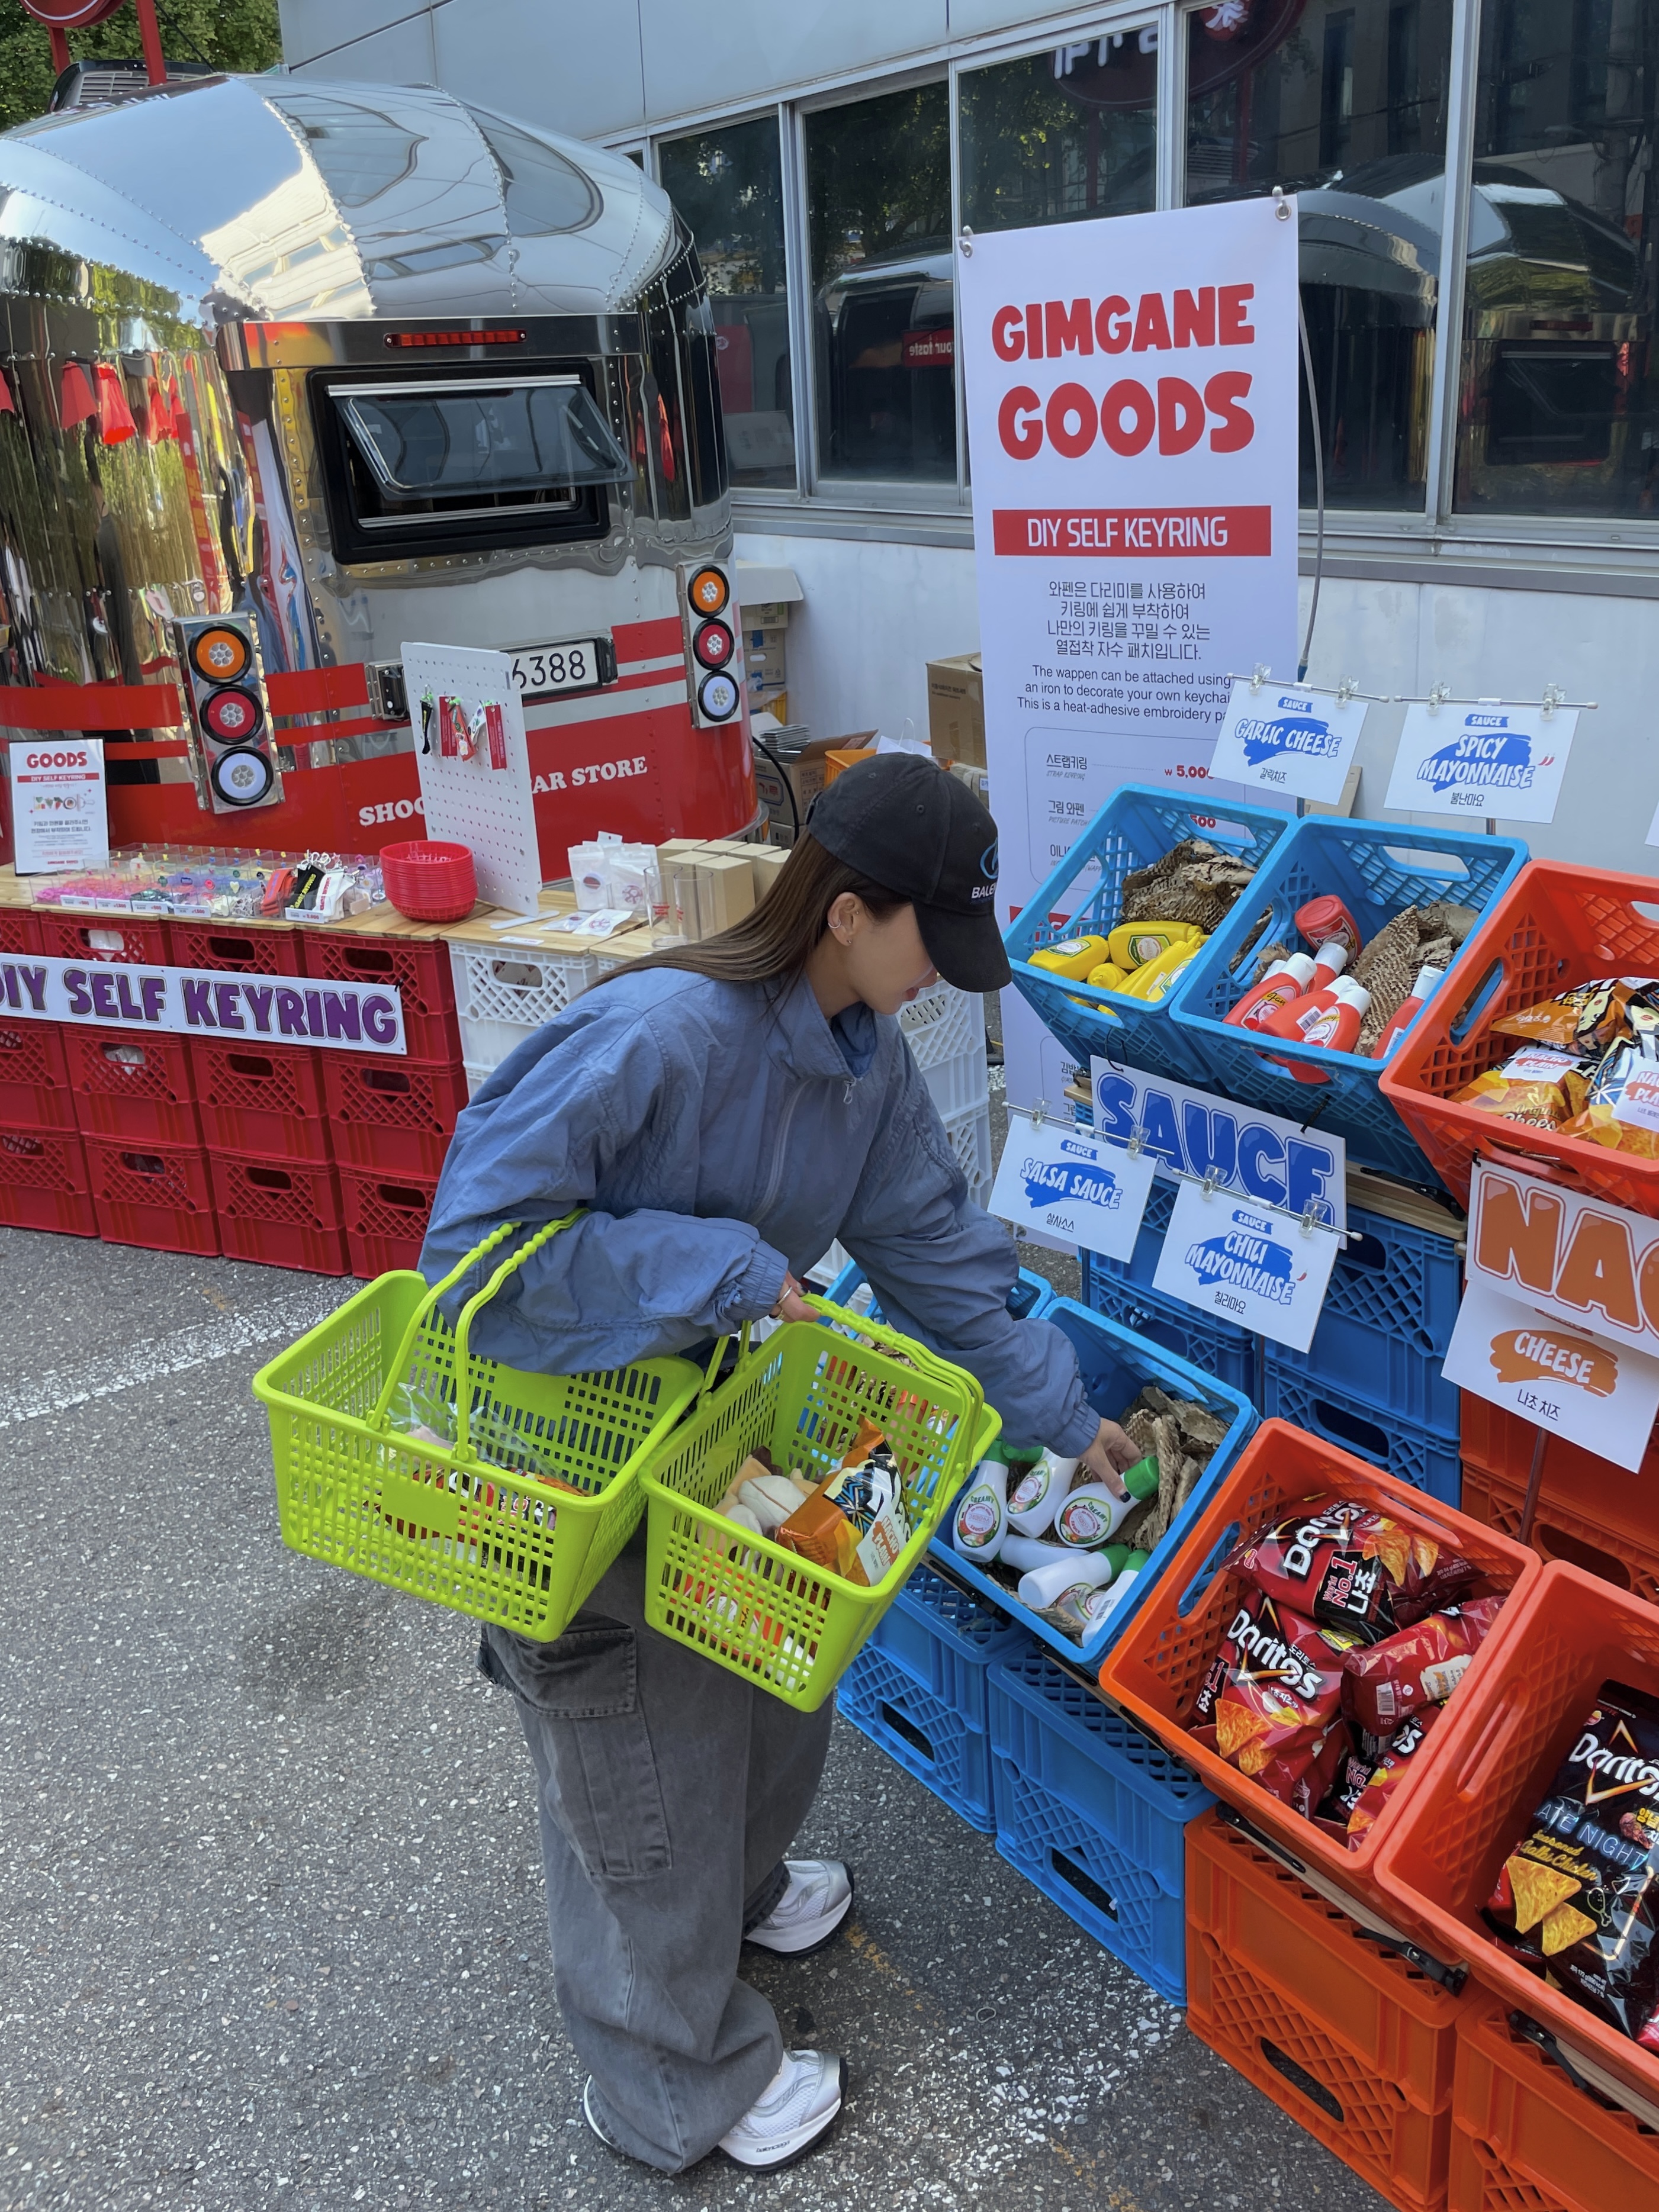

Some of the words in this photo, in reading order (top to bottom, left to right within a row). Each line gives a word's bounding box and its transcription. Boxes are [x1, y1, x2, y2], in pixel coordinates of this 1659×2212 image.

[992, 283, 1255, 362] GIMGANE
[998, 371, 1255, 460] GOODS
[1027, 519, 1061, 548] DIY
[1068, 518, 1118, 547] SELF
[1124, 516, 1228, 547] KEYRING
[1049, 581, 1087, 598] 와펜은
[1090, 582, 1144, 599] 다리미를
[1147, 582, 1206, 600] 사용하여
[1060, 601, 1098, 618] 키링에
[1102, 601, 1128, 619] 쉽게
[1132, 603, 1189, 620] 부착하여
[1047, 620, 1085, 637] 나만의
[1088, 621, 1127, 639] 키링을
[1131, 623, 1159, 639] 꾸밀
[1162, 624, 1177, 640] 수
[1181, 623, 1211, 640] 있는
[1056, 639, 1094, 656] 열접착
[1098, 641, 1124, 658] 자수
[1127, 642, 1202, 661] 패치입니다.
[1032, 665, 1053, 678] The
[1056, 669, 1098, 682] wappen
[1101, 669, 1121, 681] can
[1124, 670, 1139, 682] be
[1142, 671, 1194, 685] attached
[1197, 674, 1232, 688] using
[1025, 683, 1038, 693] an
[1041, 682, 1060, 694] iron
[1063, 684, 1073, 695] to
[1076, 685, 1124, 698] decorate
[1127, 691, 1153, 703] your
[1156, 691, 1181, 701] own
[1184, 690, 1230, 706] keychai
[1282, 698, 1308, 711] SAUCE
[1017, 697, 1039, 710] This
[1041, 698, 1050, 711] is
[1054, 701, 1060, 711] a
[1063, 700, 1140, 717] heat-adhesive
[1143, 706, 1211, 724] embroidery
[1471, 716, 1502, 726] SAUCE
[1234, 718, 1284, 746] GARLIC
[1284, 729, 1342, 758] CHEESE
[1455, 733, 1508, 760] SPICY
[27, 751, 88, 768] GOODS
[1046, 754, 1088, 770] 스트랩키링
[532, 771, 567, 794] AR
[571, 755, 648, 787] STORE
[1064, 772, 1086, 781] KEYRING
[1259, 767, 1287, 784] 갈릭치즈
[1417, 758, 1536, 790] MAYONNAISE
[1048, 800, 1064, 814] 그림
[1066, 801, 1085, 816] 와펜
[1450, 792, 1485, 807] 불난마요
[1048, 816, 1070, 825] PICTURE
[0, 964, 49, 1013] IY
[61, 966, 167, 1023] SELF
[180, 977, 398, 1046] KEYRING
[1522, 1059, 1560, 1070] PLAIN
[1526, 1052, 1570, 1064] NACHO
[1066, 1142, 1092, 1158] SAUCE
[1097, 1071, 1335, 1231] SAUCE
[1020, 1157, 1069, 1192] SALSA
[1069, 1174, 1123, 1210] SAUCE
[1046, 1213, 1075, 1233] 살사소스
[1237, 1213, 1267, 1232] SAUCE
[1224, 1230, 1269, 1265] CHILI
[1474, 1170, 1659, 1342] NA
[1185, 1243, 1296, 1305] MAYONNAISE
[1214, 1290, 1246, 1315] 칠리마요
[1513, 1331, 1594, 1384] CHEESE
[1517, 1388, 1538, 1411] 나초
[1538, 1399, 1561, 1421] 치즈
[971, 1495, 995, 1503] CREAMY
[1088, 1501, 1108, 1523] CREAMY
[880, 1515, 900, 1555] NACHO
[874, 1532, 892, 1566] PLAIN
[1323, 1575, 1338, 1602] World
[1332, 1556, 1358, 1608] No.1
[1347, 1569, 1377, 1615] 나초
[1227, 1609, 1323, 1699] Doritos
[1288, 1643, 1317, 1669] 도리토스
[1348, 1756, 1372, 1775] World
[1568, 1733, 1659, 1802] Dorito
[1532, 1829, 1584, 1856] Seasoned
[1578, 1824, 1649, 1870] NIGHT
[1519, 1839, 1552, 1863] Galbi
[1551, 1853, 1598, 1881] Chicken
